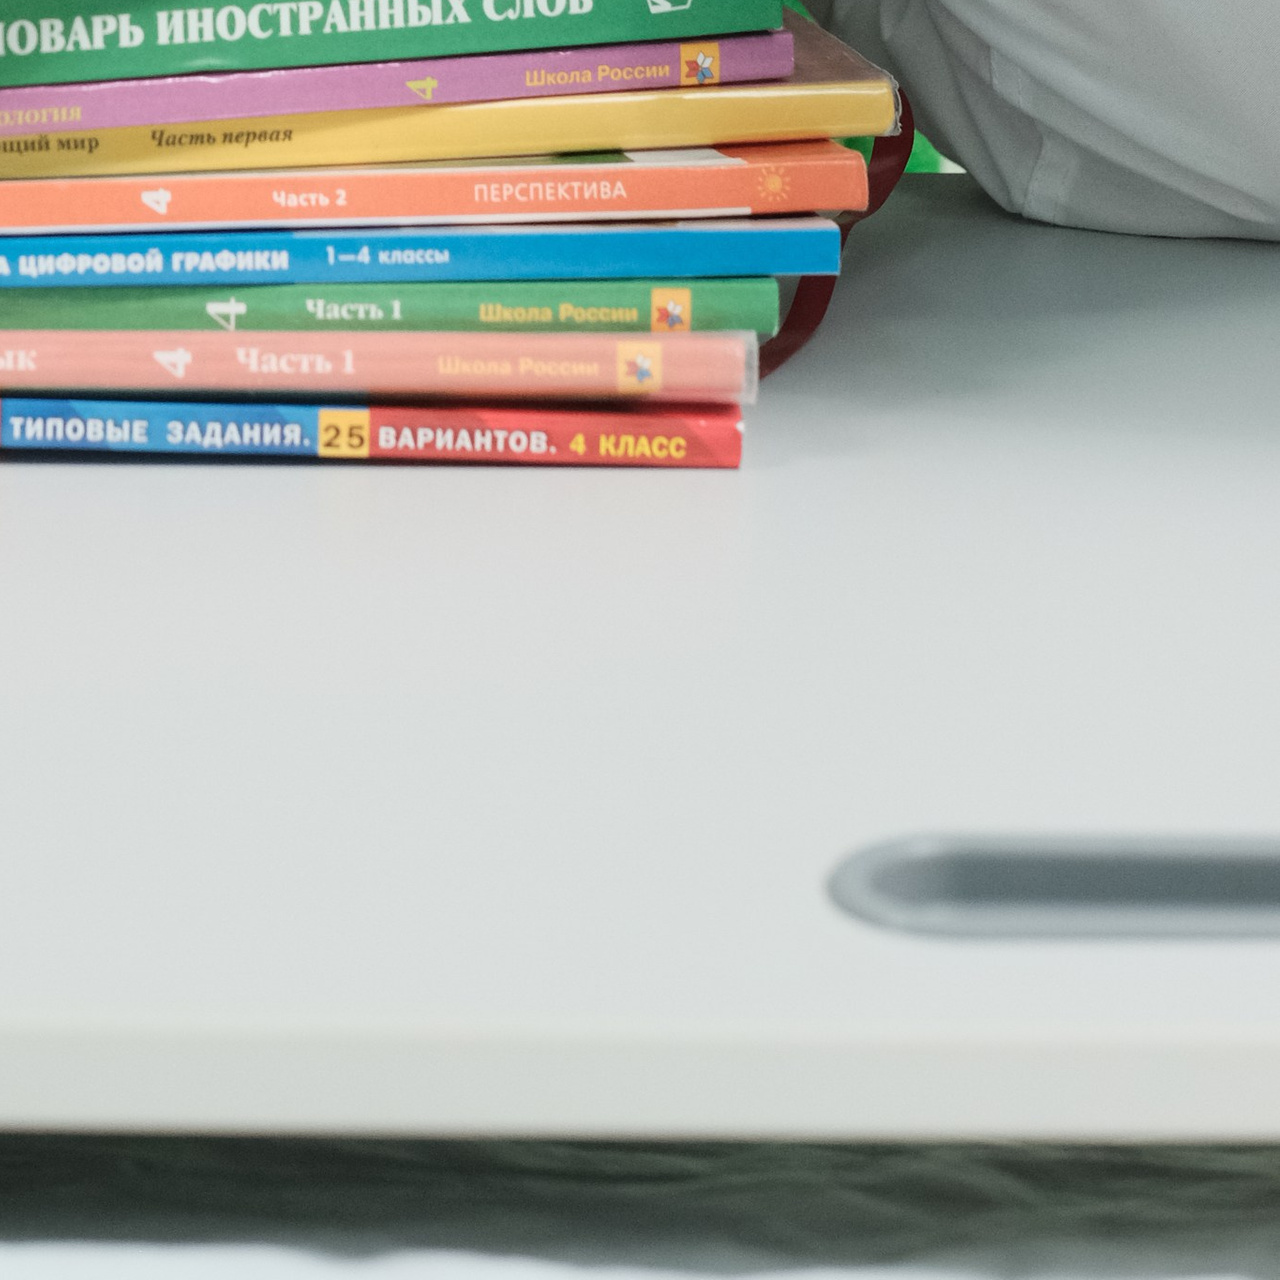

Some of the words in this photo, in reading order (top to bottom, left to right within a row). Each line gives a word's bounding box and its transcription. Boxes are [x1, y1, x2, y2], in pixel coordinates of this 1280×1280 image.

[525, 66, 593, 87] Школа
[598, 62, 671, 83] России
[56, 134, 100, 154] мир
[149, 127, 214, 151] Часть
[221, 124, 294, 148] первая
[141, 188, 172, 215] 4
[272, 191, 330, 209] Часть
[335, 189, 347, 207] 2
[474, 180, 627, 204] ПЕРСПЕКТИВА
[18, 247, 163, 280] ЦИФРОВОЙ
[171, 249, 289, 273] ГРАФИКИ
[377, 247, 450, 265] классы
[305, 298, 384, 322] Часть
[391, 300, 402, 320] 1
[479, 303, 552, 323] Школа
[558, 302, 638, 323] России
[236, 346, 331, 375] Часть
[342, 350, 356, 375] 1
[437, 355, 512, 377] Школа
[518, 357, 600, 377] России
[10, 415, 149, 443] ТИПОВЫЕ
[166, 419, 311, 448] ЗАДАНИЯ.
[323, 424, 366, 450] 25
[378, 426, 557, 455] ВАРИАНТОВ.
[569, 431, 586, 455] 4
[599, 432, 688, 459] КЛАСС
